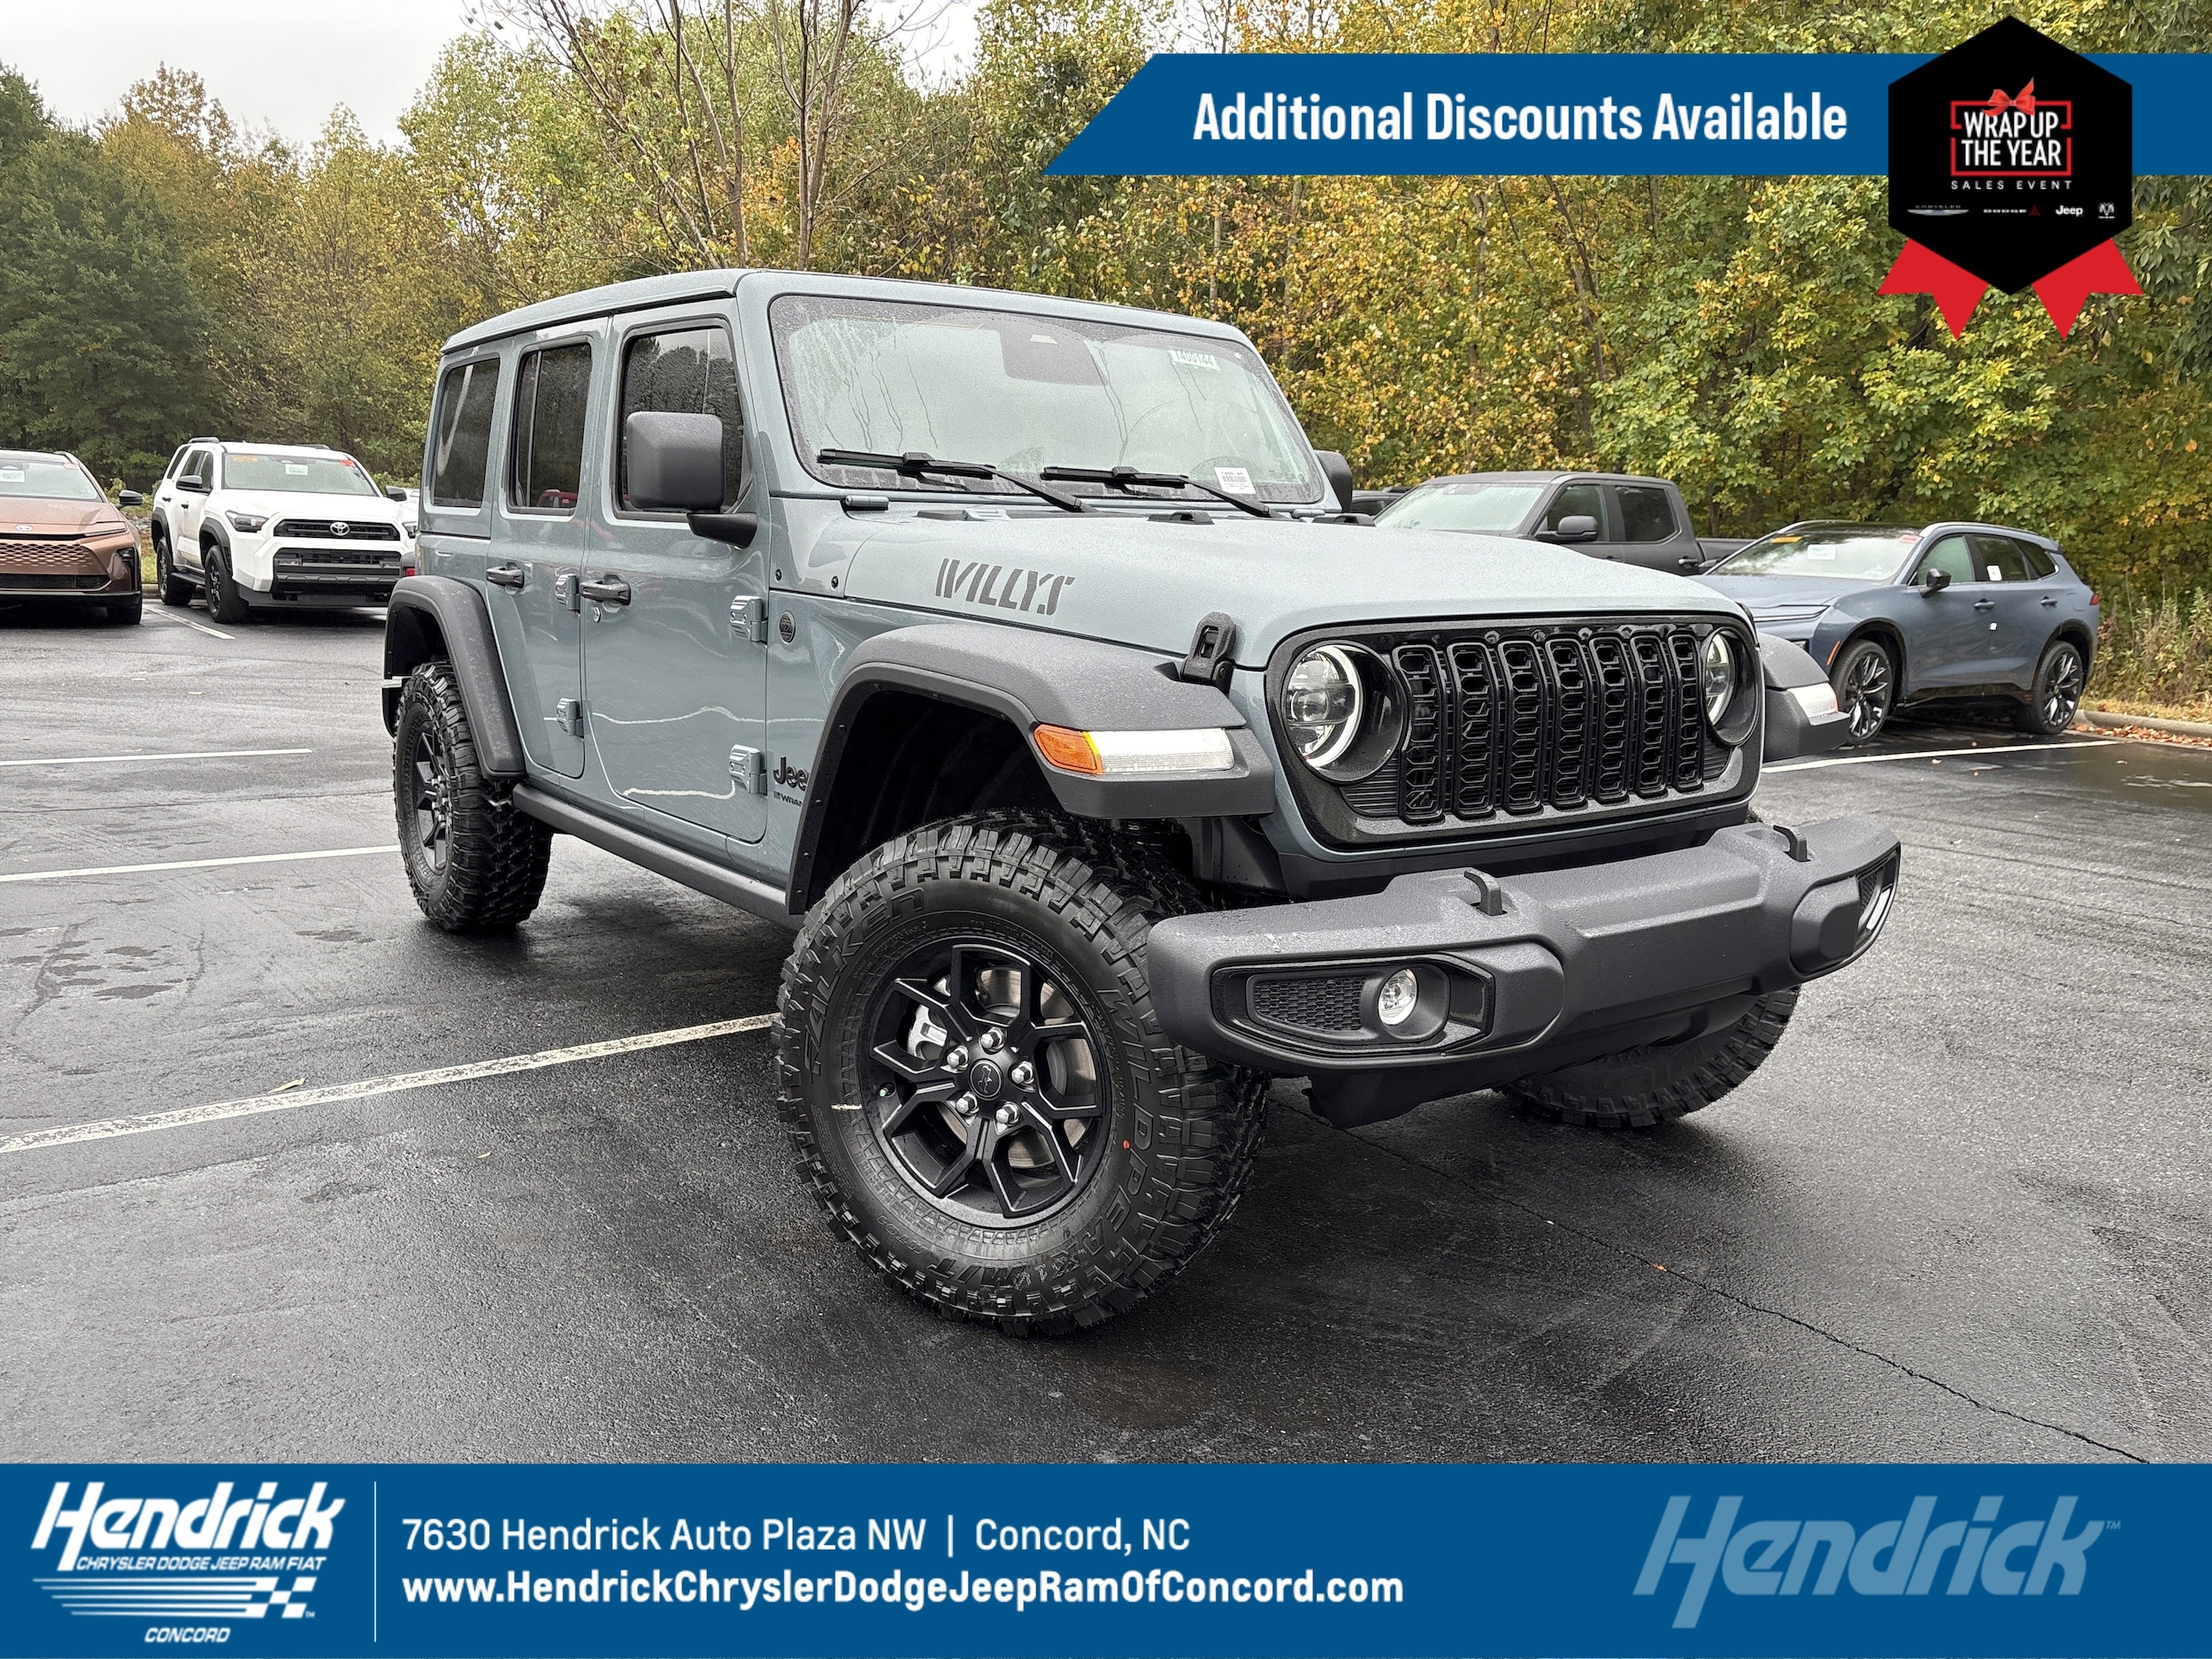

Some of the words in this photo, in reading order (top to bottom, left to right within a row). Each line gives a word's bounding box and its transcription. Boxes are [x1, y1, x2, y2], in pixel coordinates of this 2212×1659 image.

[935, 557, 1076, 616] WILLYS
[773, 756, 810, 792] Jee
[780, 793, 803, 808] WRAN
